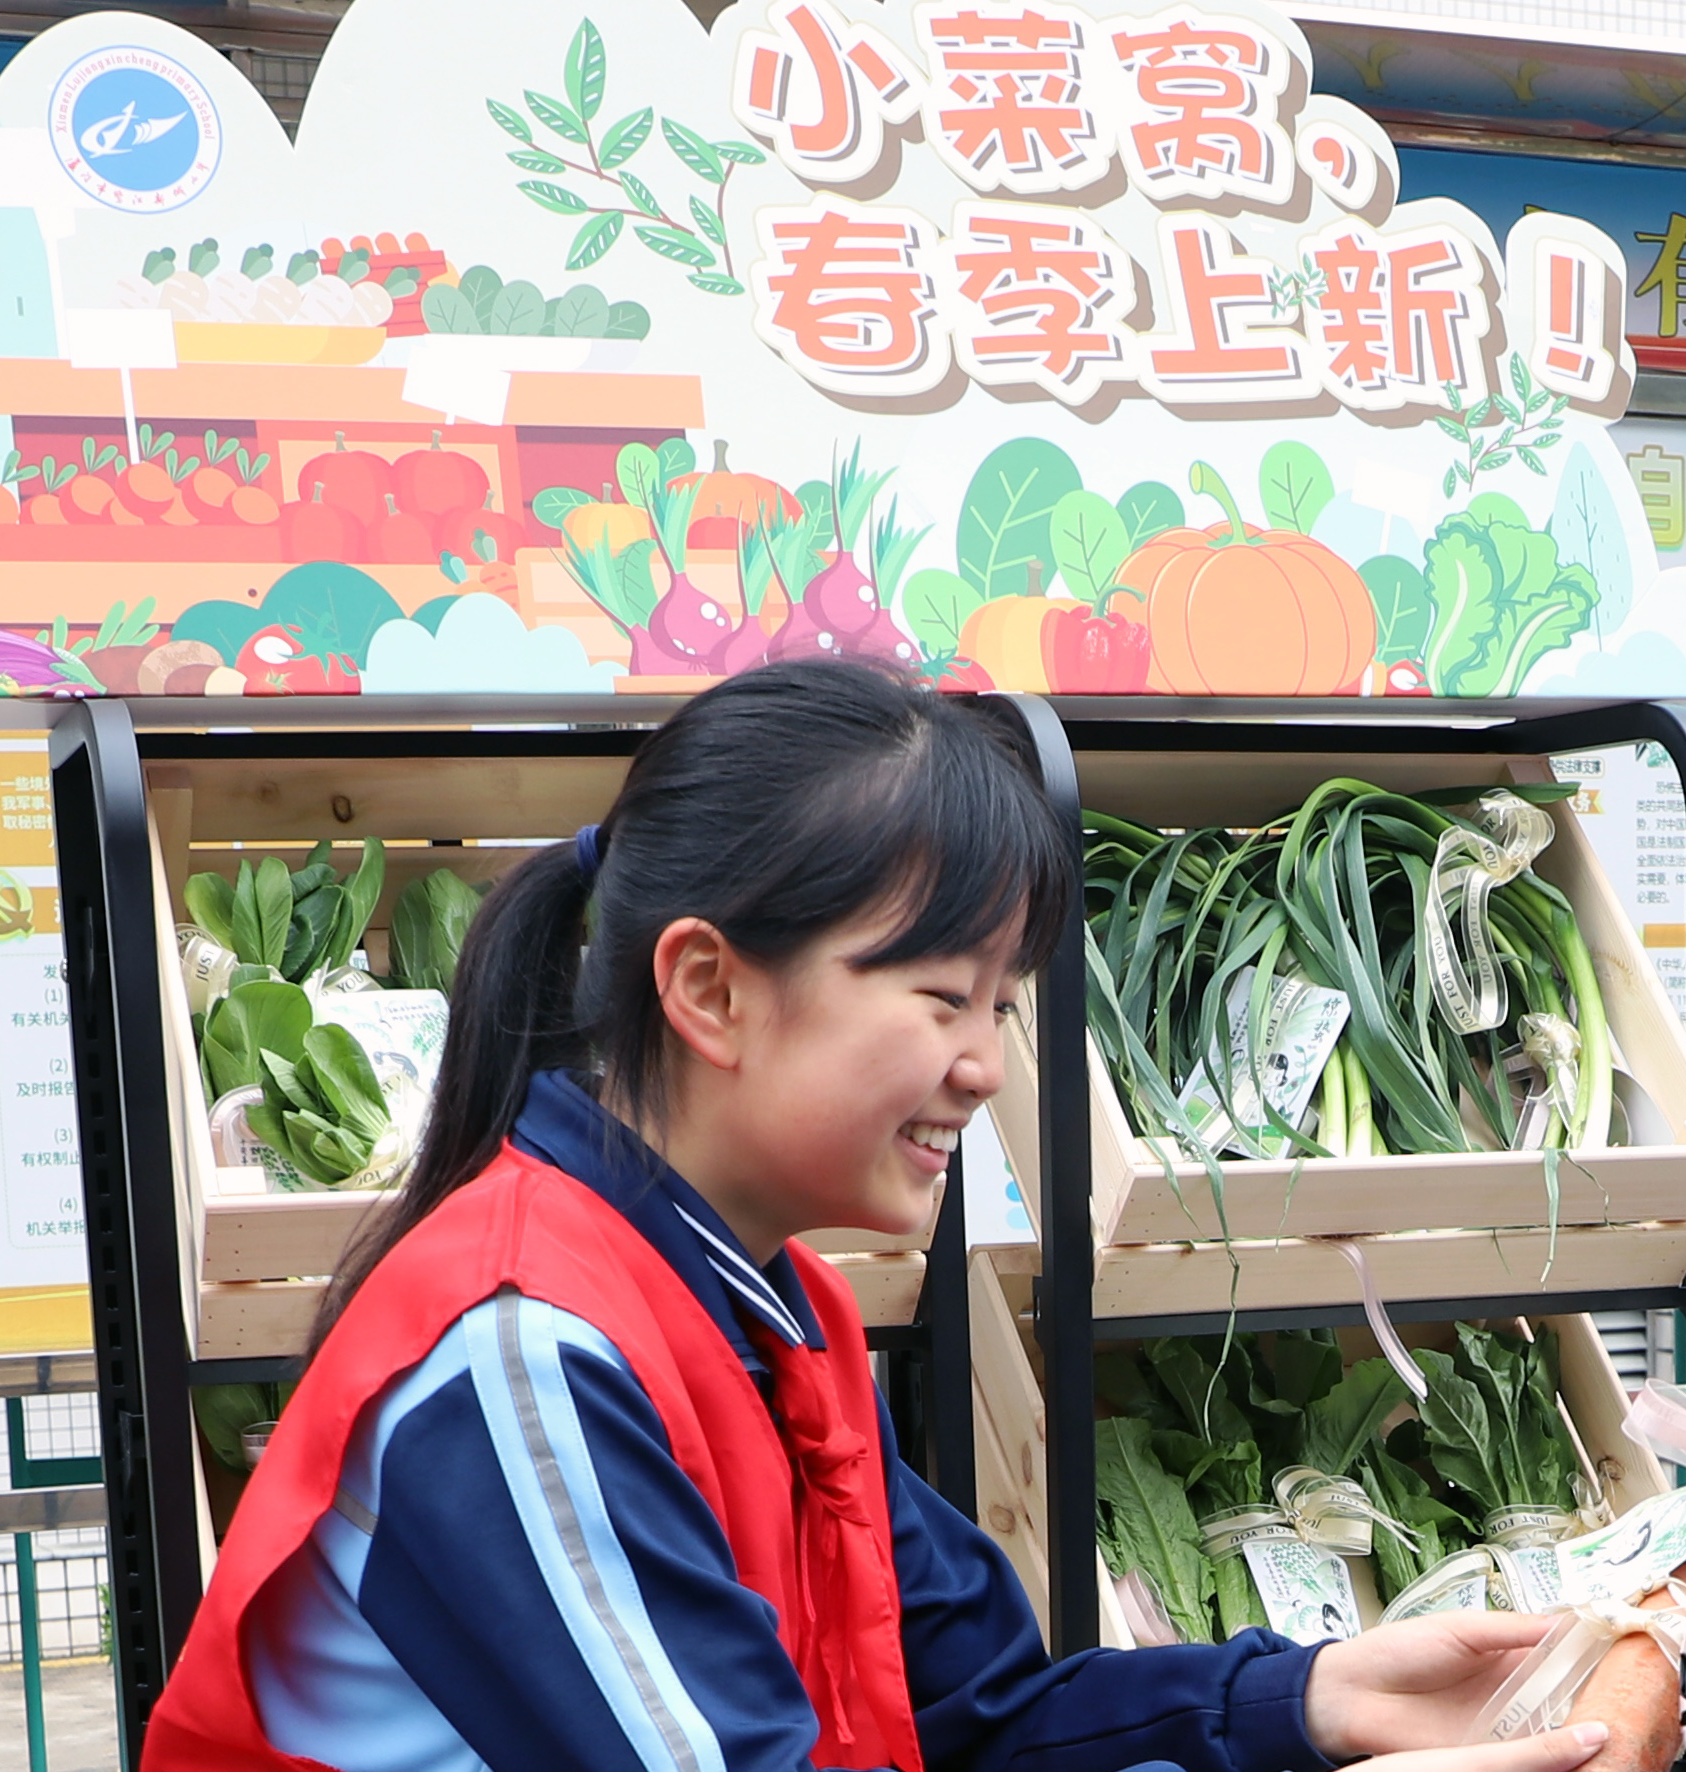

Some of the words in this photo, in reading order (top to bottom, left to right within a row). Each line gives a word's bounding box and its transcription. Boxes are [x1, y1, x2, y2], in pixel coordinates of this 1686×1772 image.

[747, 4, 1345, 180] 小菜窝，
[768, 209, 1595, 386] 春季上新！
